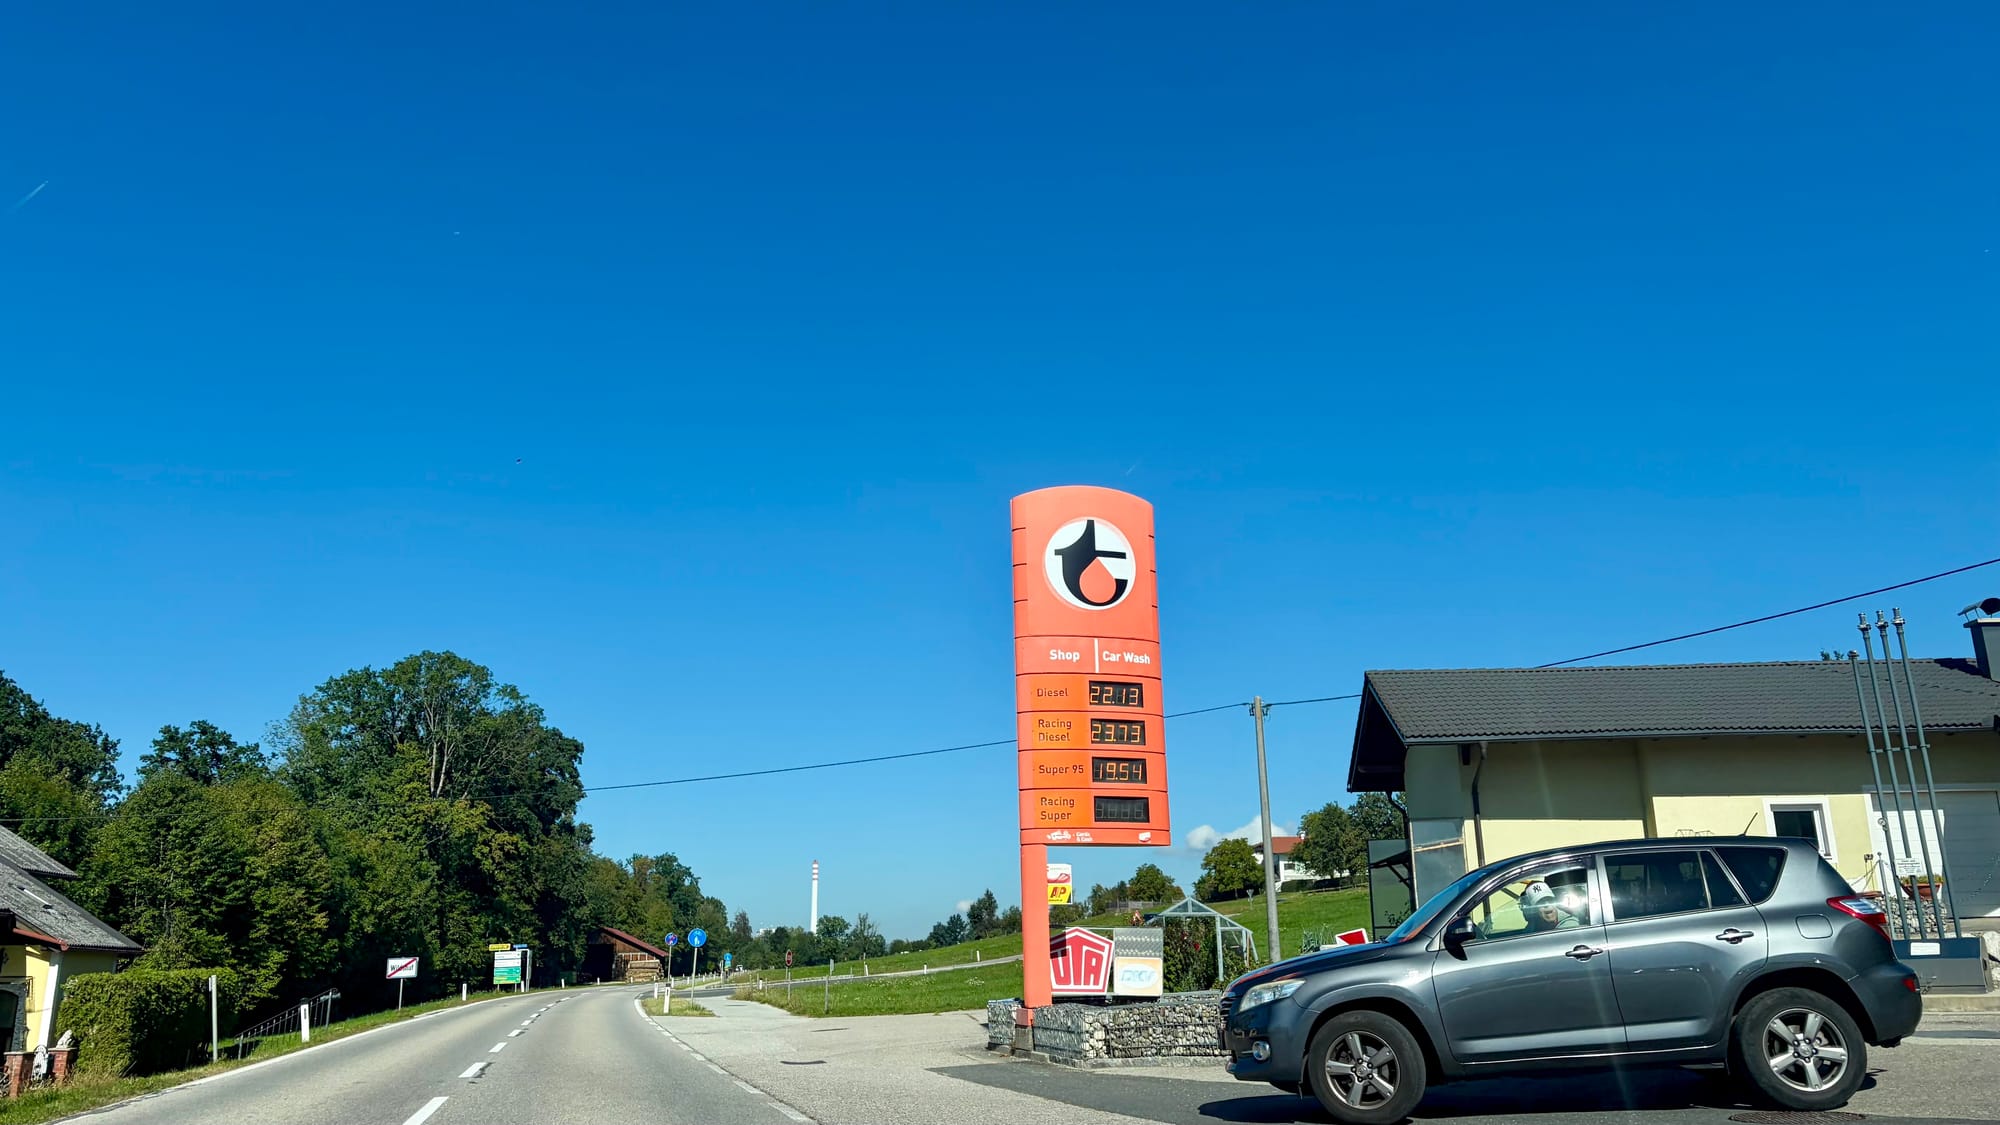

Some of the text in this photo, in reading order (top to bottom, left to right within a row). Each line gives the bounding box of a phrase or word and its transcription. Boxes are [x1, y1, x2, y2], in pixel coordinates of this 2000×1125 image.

[1049, 649, 1080, 662] Shop
[1102, 651, 1151, 664] Car Wash
[1036, 688, 1069, 697] Diesel
[1038, 718, 1072, 729] Racing
[1038, 732, 1071, 741] Diesel
[1038, 764, 1084, 775] Super 95
[1099, 762, 1142, 781] 19.54
[1040, 796, 1075, 808] Racing
[1040, 811, 1072, 822] Super
[1051, 934, 1106, 986] UTA
